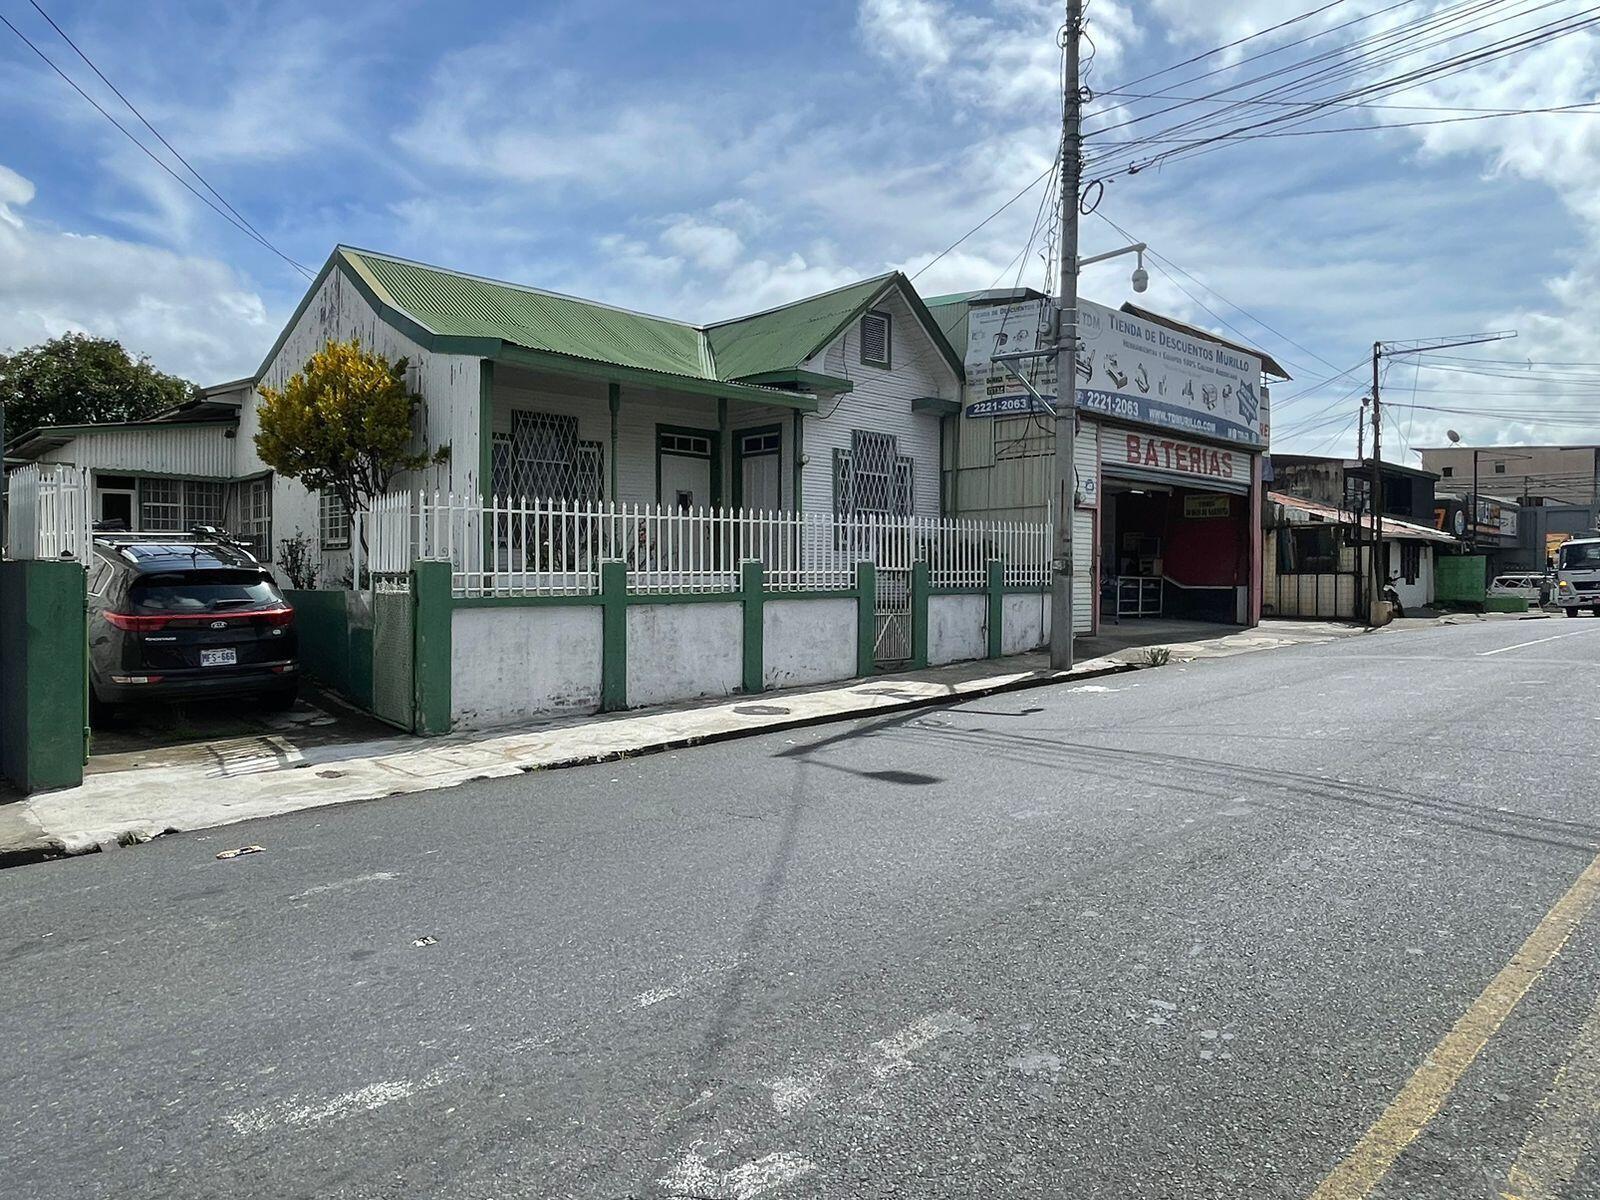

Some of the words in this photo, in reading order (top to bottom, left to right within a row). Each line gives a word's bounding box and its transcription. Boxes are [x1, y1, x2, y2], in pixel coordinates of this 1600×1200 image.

[1108, 313, 1142, 339] TIENDA
[1145, 330, 1156, 344] DE
[1159, 333, 1213, 361] DESCUENTOS
[1216, 350, 1249, 373] MURILLO
[974, 399, 1027, 414] 2221-2063
[1087, 391, 1139, 417] 2221-2063
[1126, 434, 1233, 478] BATERIAS
